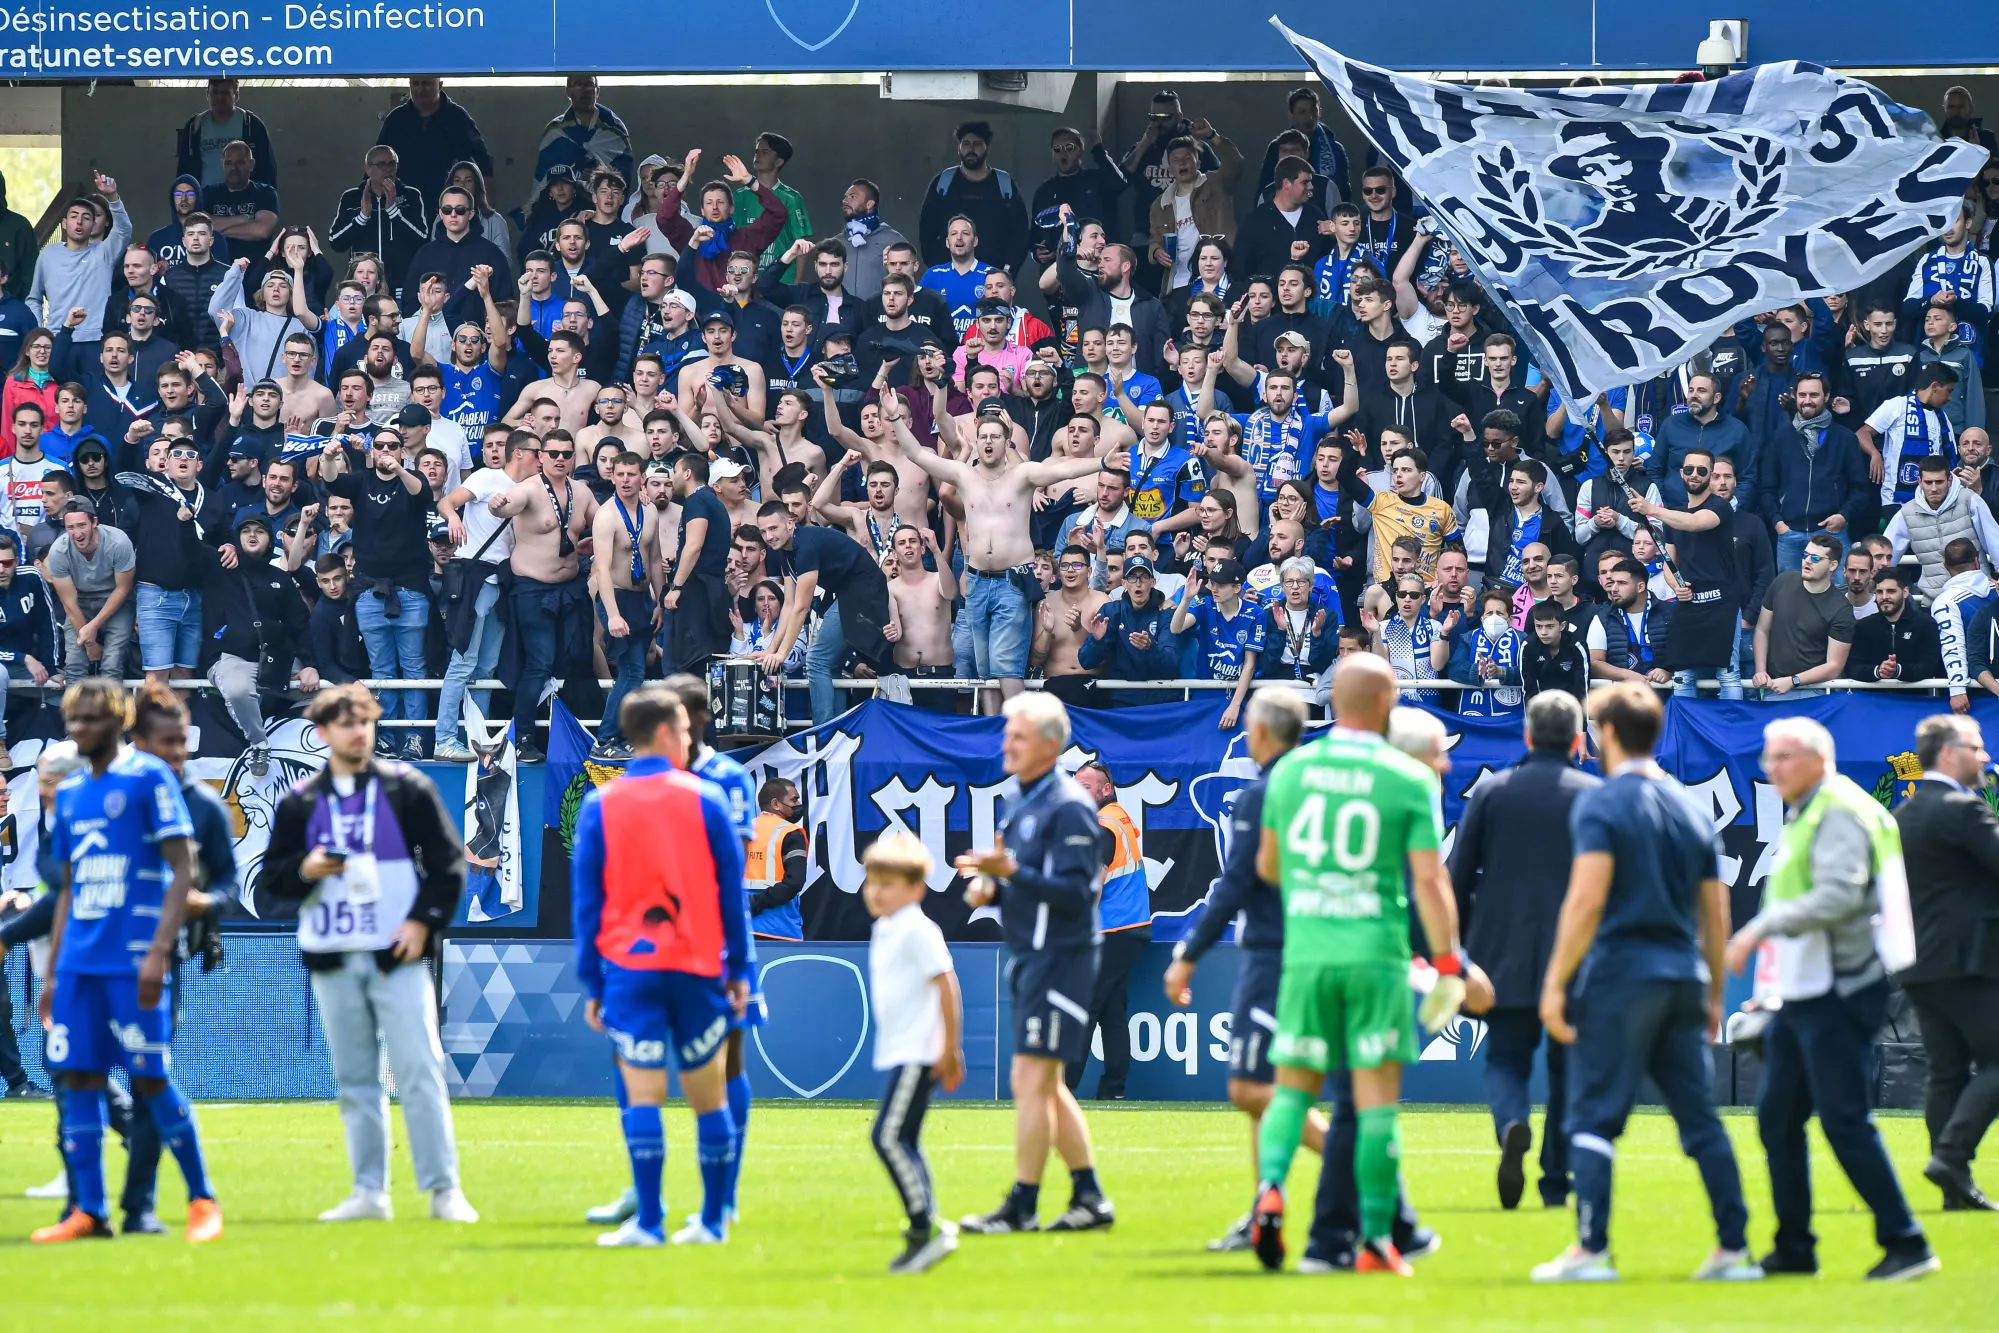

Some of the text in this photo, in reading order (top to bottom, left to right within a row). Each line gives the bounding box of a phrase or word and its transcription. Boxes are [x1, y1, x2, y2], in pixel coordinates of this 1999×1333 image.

[285, 3, 484, 30] Désinfection
[0, 39, 332, 68] ratunet-services.com
[1503, 143, 1975, 402] TROYES
[908, 314, 932, 325] AIR
[459, 411, 490, 426] BABEAU
[1906, 389, 1920, 437] ESTA
[20, 508, 40, 516] MSC
[1697, 588, 1721, 600] TROYES
[1934, 603, 1965, 684] TROYES
[1286, 793, 1382, 872] 40
[310, 900, 355, 939] 05
[47, 1021, 71, 1063] 6
